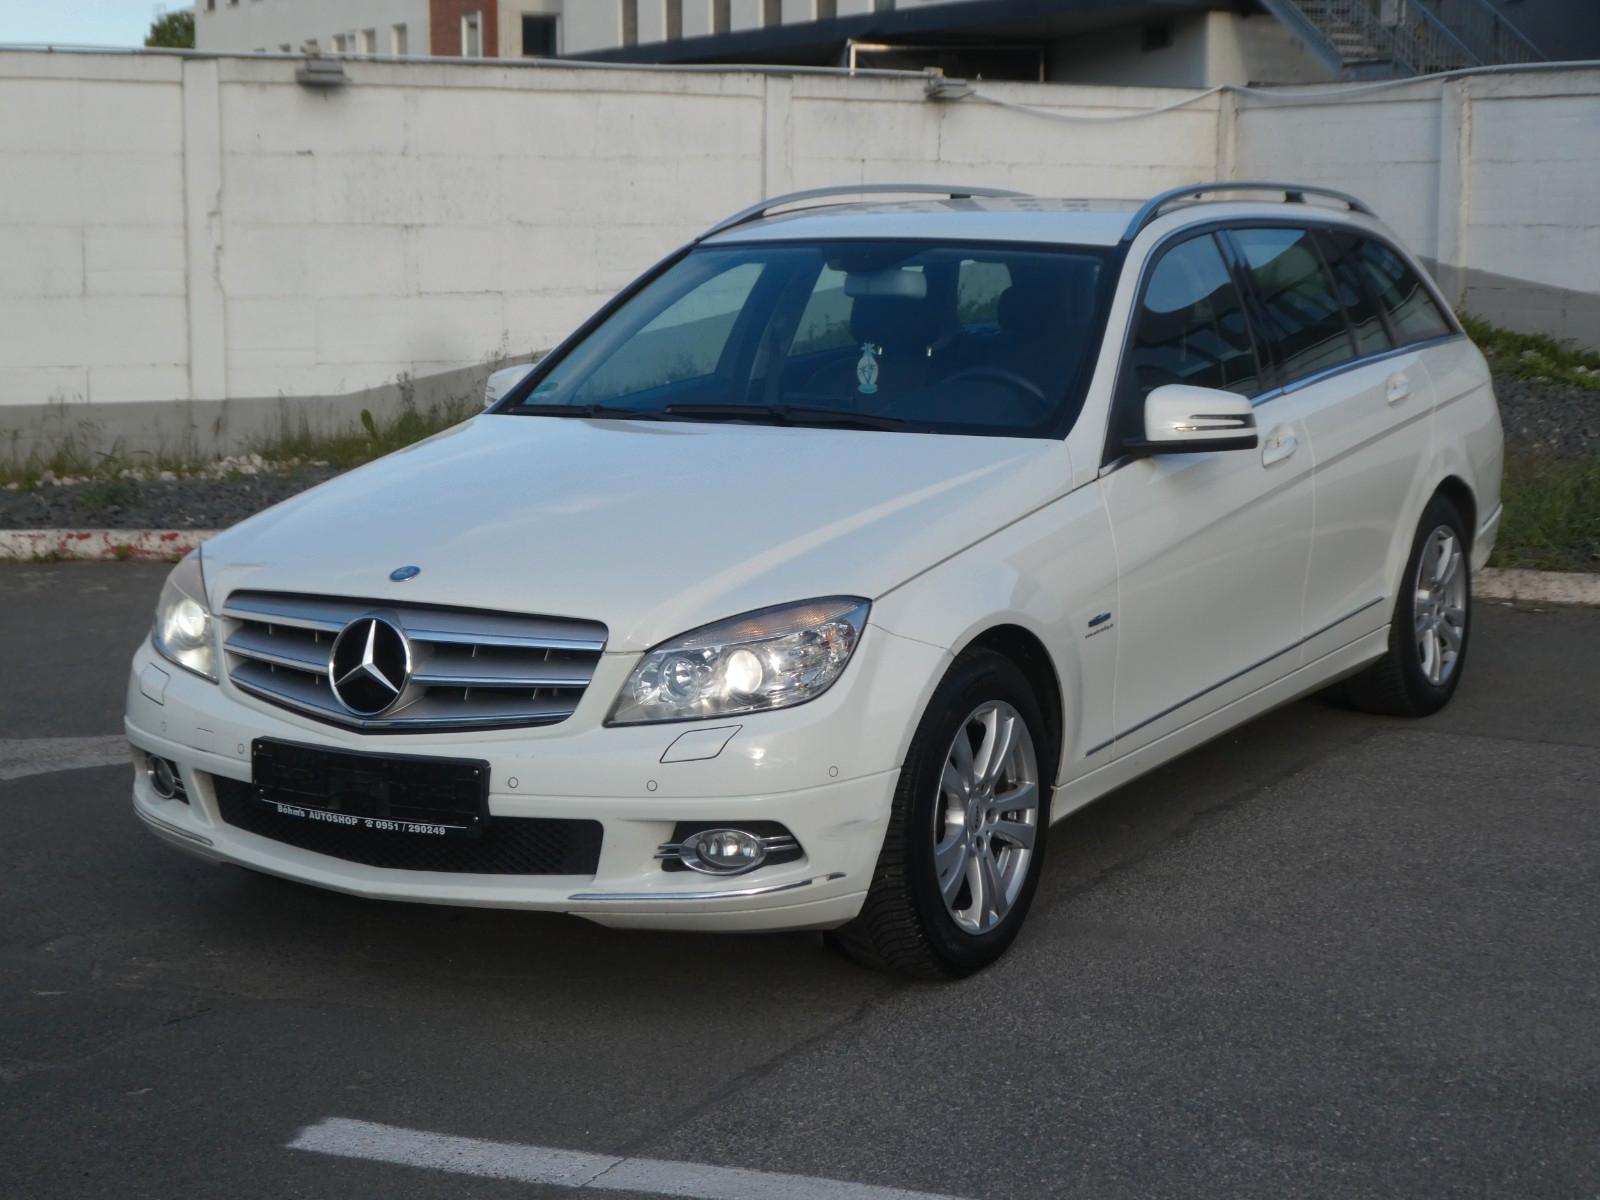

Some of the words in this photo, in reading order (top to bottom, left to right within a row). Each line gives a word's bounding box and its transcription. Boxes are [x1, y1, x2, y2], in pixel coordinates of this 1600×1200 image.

[309, 811, 358, 825] AUTOSHOP
[375, 821, 399, 831] 0951
[408, 824, 446, 836] 290249
